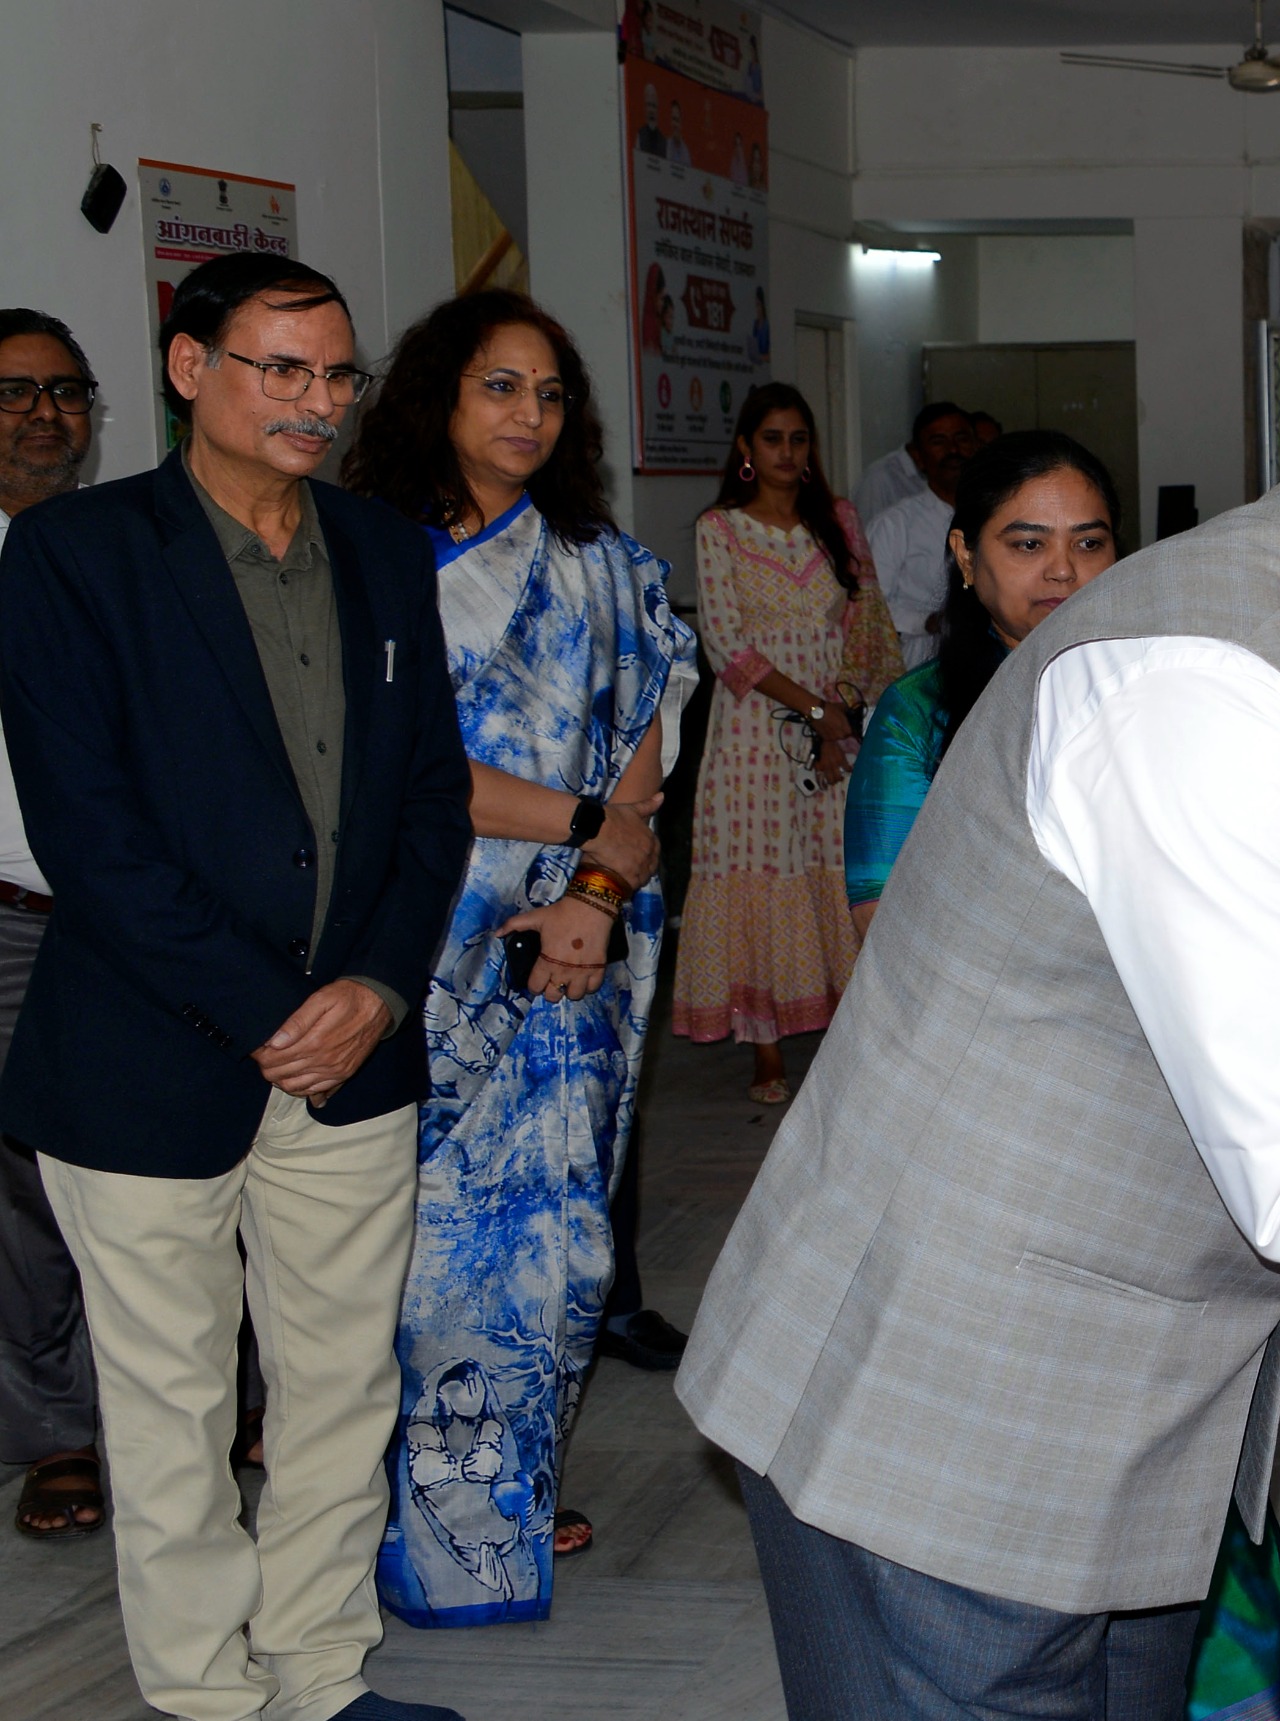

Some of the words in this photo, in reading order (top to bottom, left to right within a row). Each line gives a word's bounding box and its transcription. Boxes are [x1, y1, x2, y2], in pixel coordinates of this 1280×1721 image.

[157, 215, 249, 250] आंगनबाड़ी
[254, 227, 288, 254] केन्द्र
[656, 197, 716, 242] राजस्थान
[719, 207, 753, 250] संपर्क
[705, 300, 725, 329] 181
